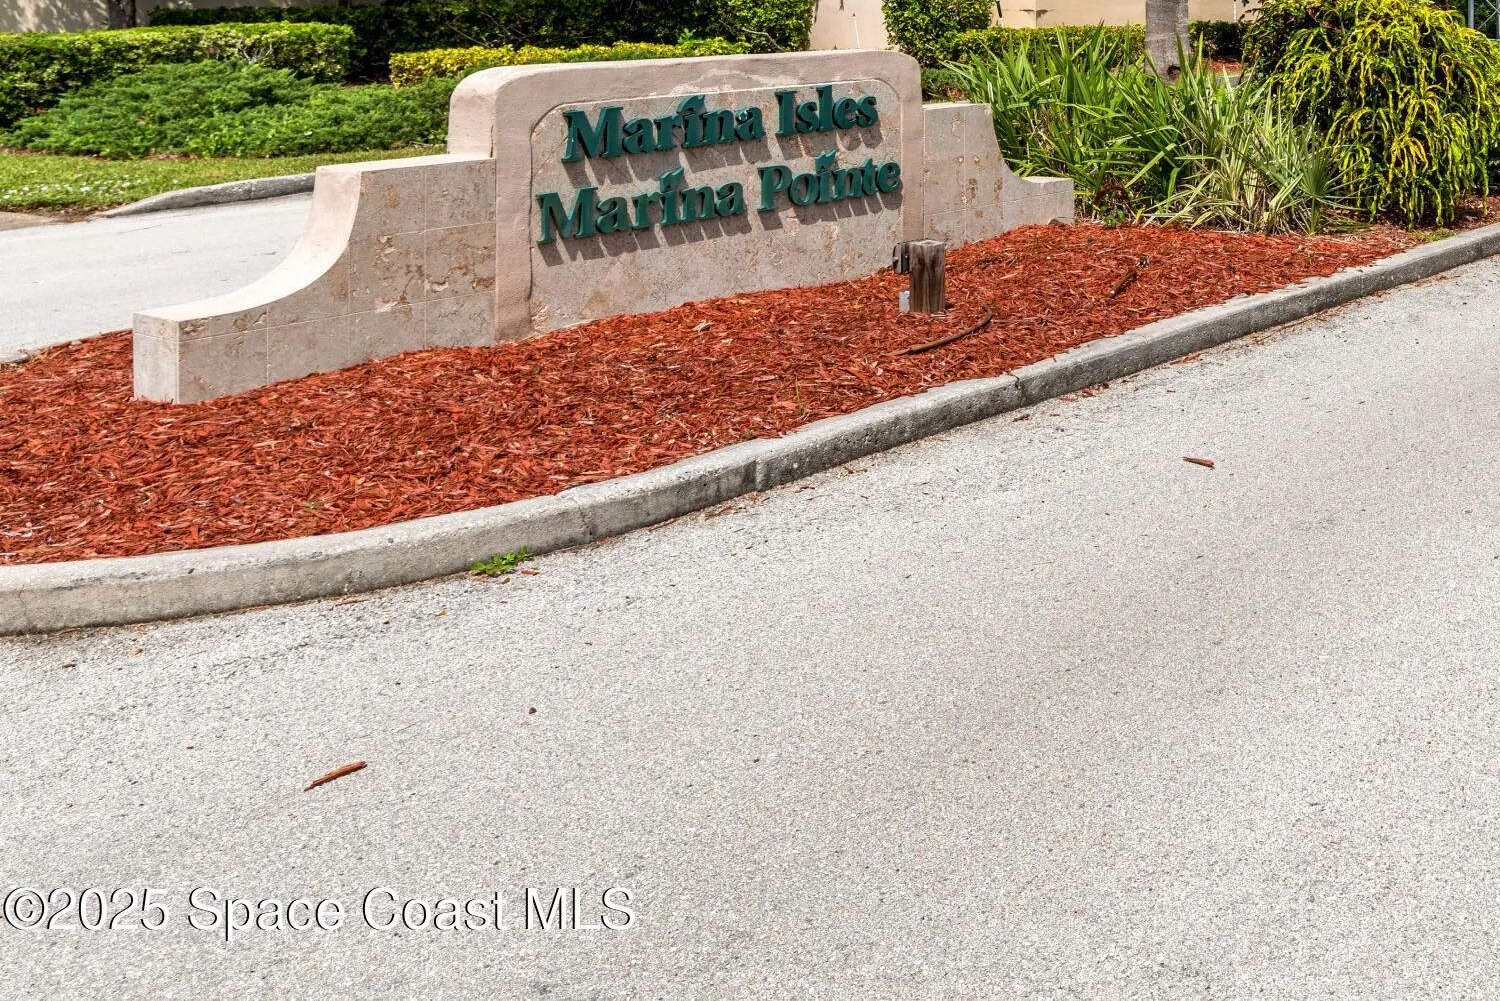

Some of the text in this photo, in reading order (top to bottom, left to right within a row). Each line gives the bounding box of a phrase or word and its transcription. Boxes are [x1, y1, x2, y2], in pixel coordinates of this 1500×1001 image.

[562, 84, 878, 163] Marina Isles
[536, 150, 901, 243] Marina Pointe
